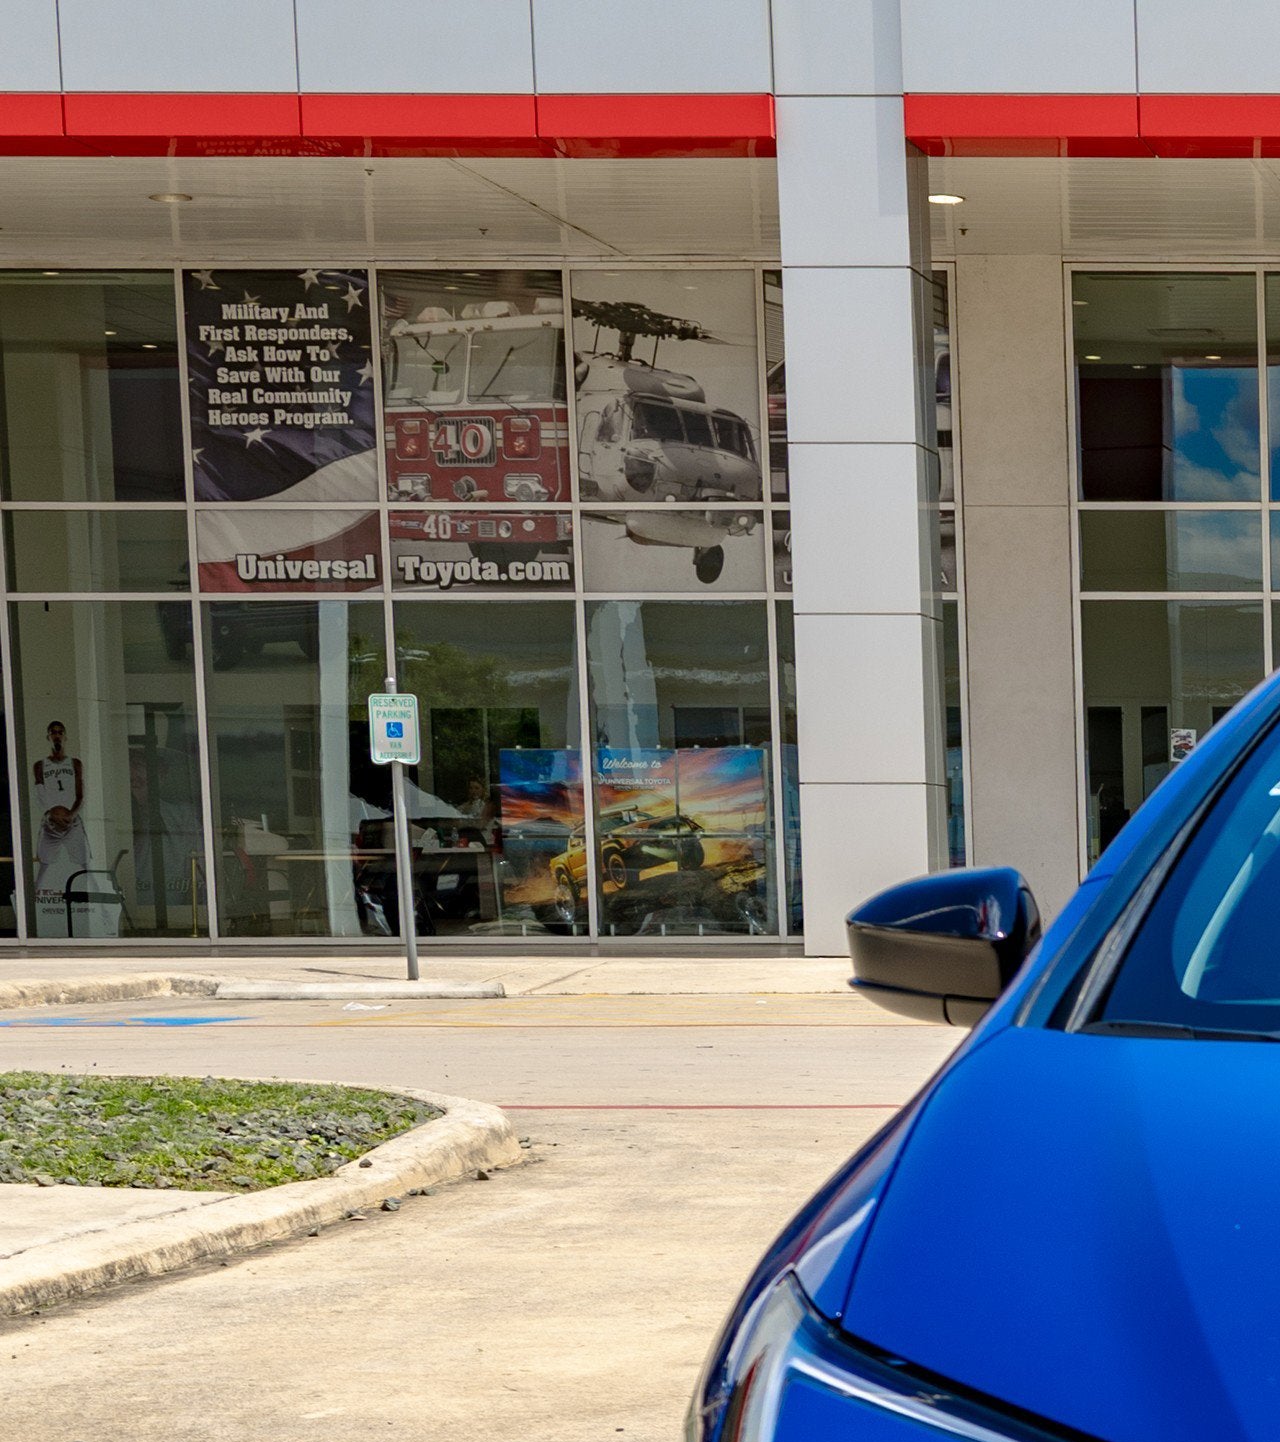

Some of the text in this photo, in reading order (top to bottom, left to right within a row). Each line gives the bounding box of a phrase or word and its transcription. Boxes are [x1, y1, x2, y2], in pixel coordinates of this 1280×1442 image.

[221, 303, 329, 323] Military And
[199, 325, 353, 344] First Responders,
[225, 346, 330, 362] Ask How To
[216, 367, 341, 383] Save With Our
[208, 388, 352, 407] Real Community
[208, 409, 354, 429] Heroes Program.
[431, 423, 492, 460] 40
[235, 554, 571, 588] Universal Toyota.com
[376, 710, 411, 719] PARKING
[603, 757, 648, 769] Welcome
